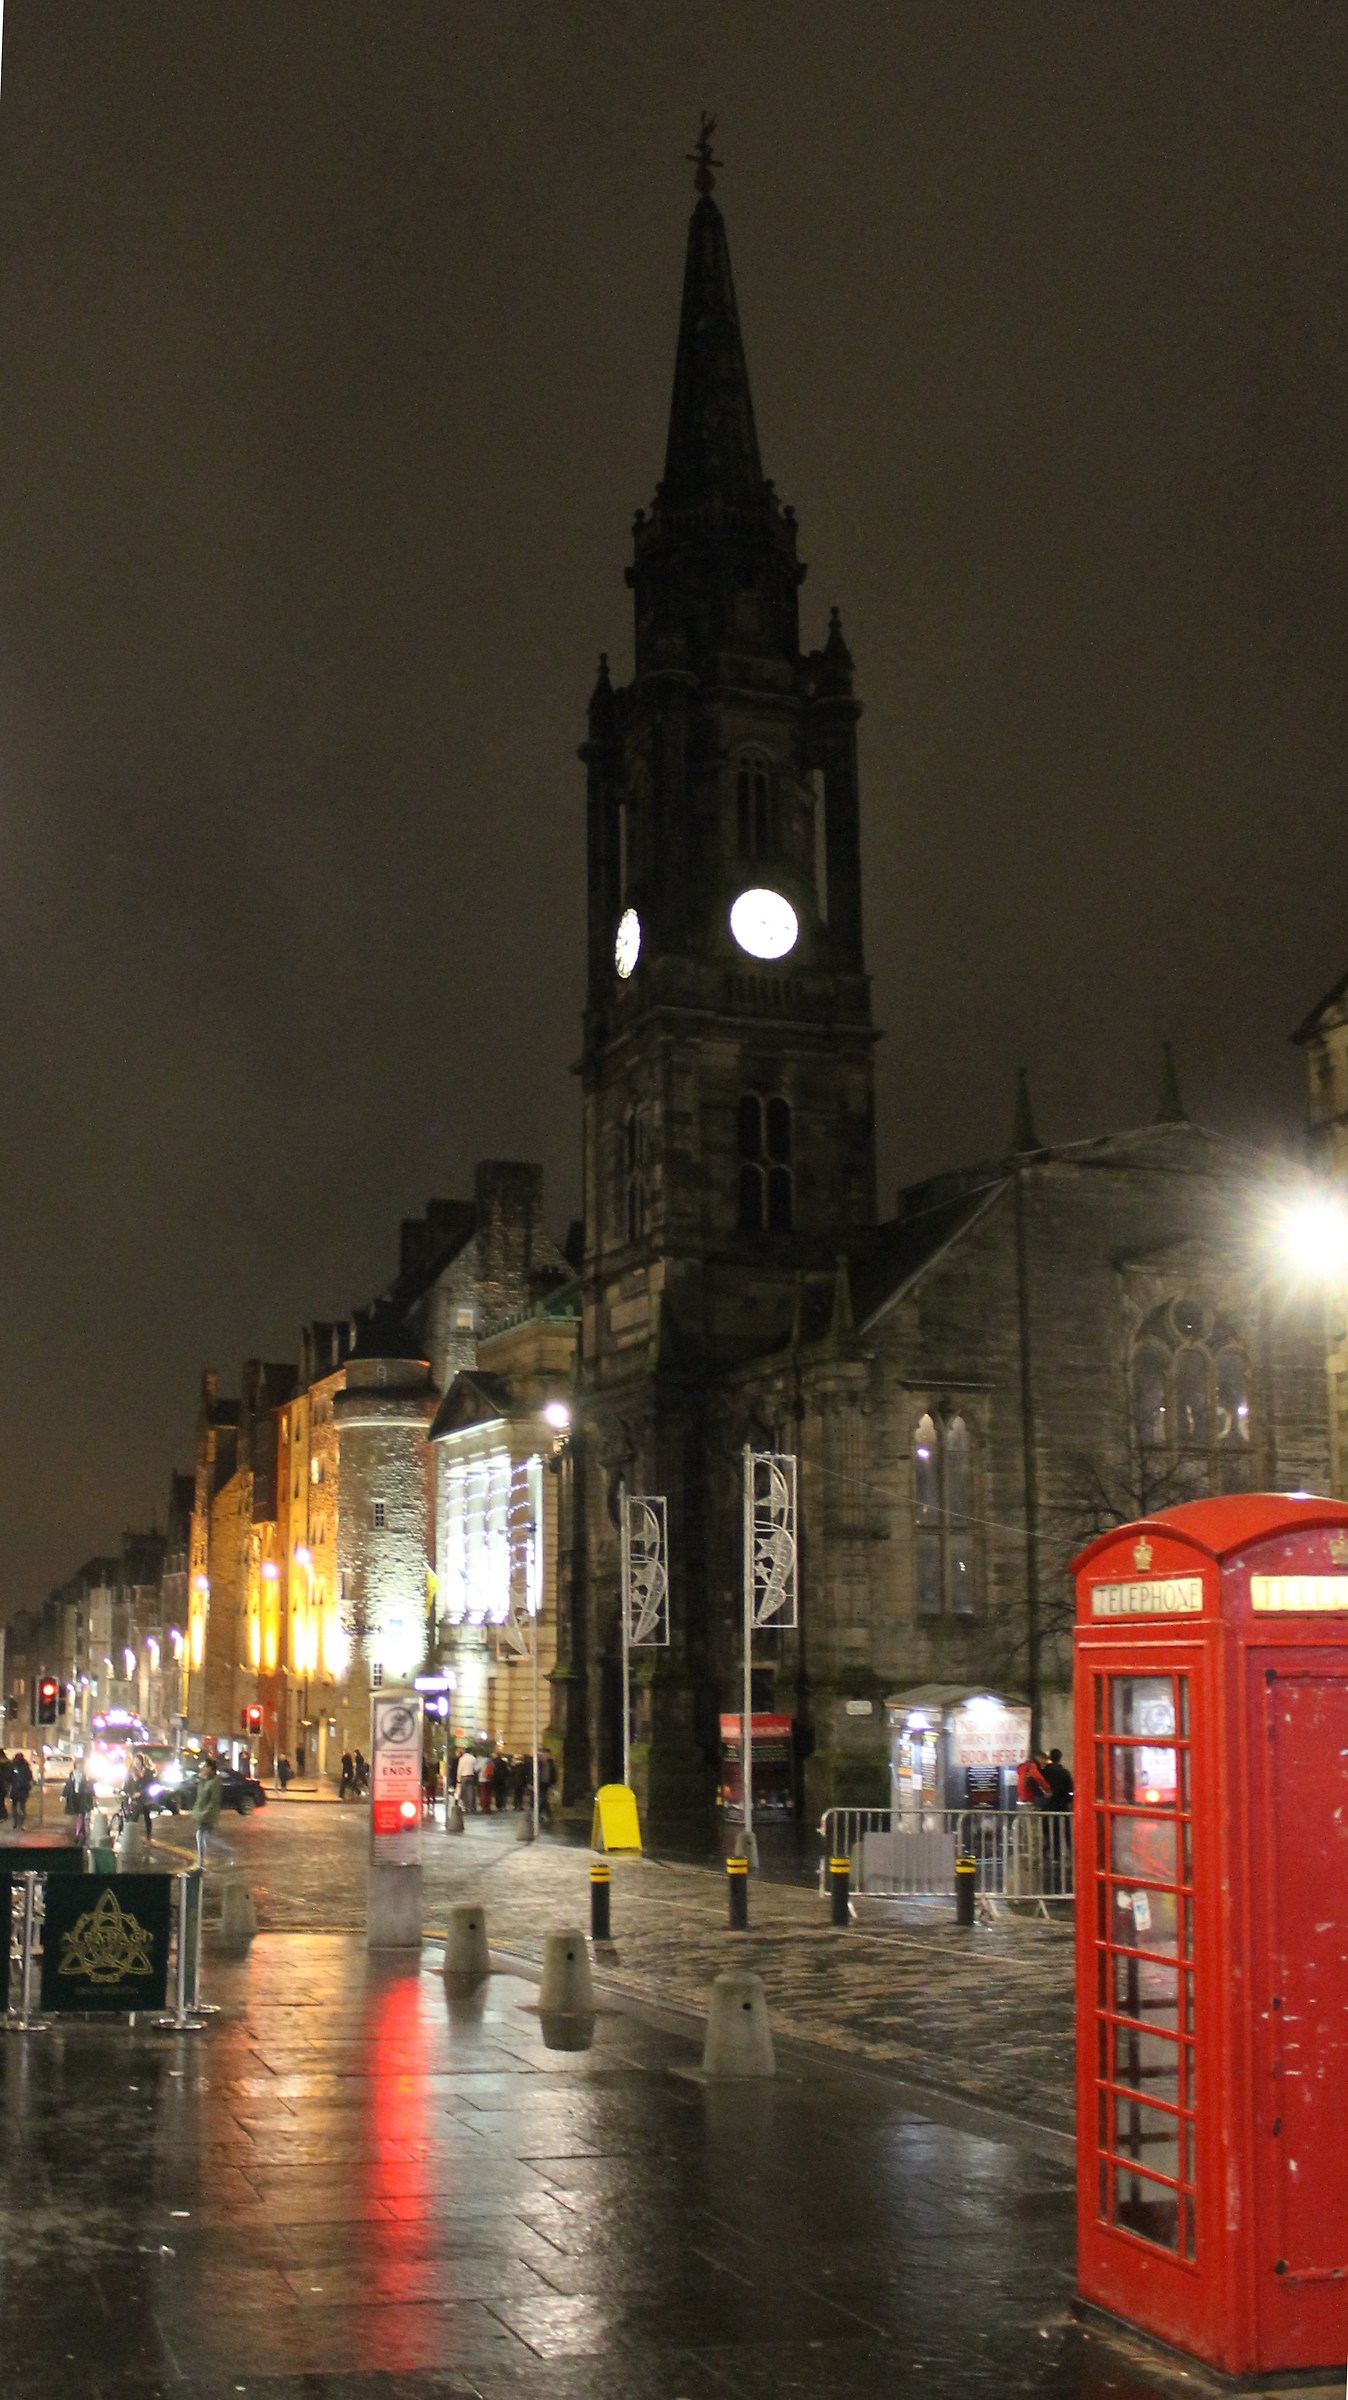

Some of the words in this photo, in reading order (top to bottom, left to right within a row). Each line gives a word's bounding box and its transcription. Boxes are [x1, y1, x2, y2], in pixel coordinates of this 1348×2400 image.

[1096, 1583, 1199, 1613] TELEPHONE
[960, 1749, 989, 1763] BOOK
[991, 1748, 1017, 1763] HERE
[382, 1766, 412, 1776] ENDS
